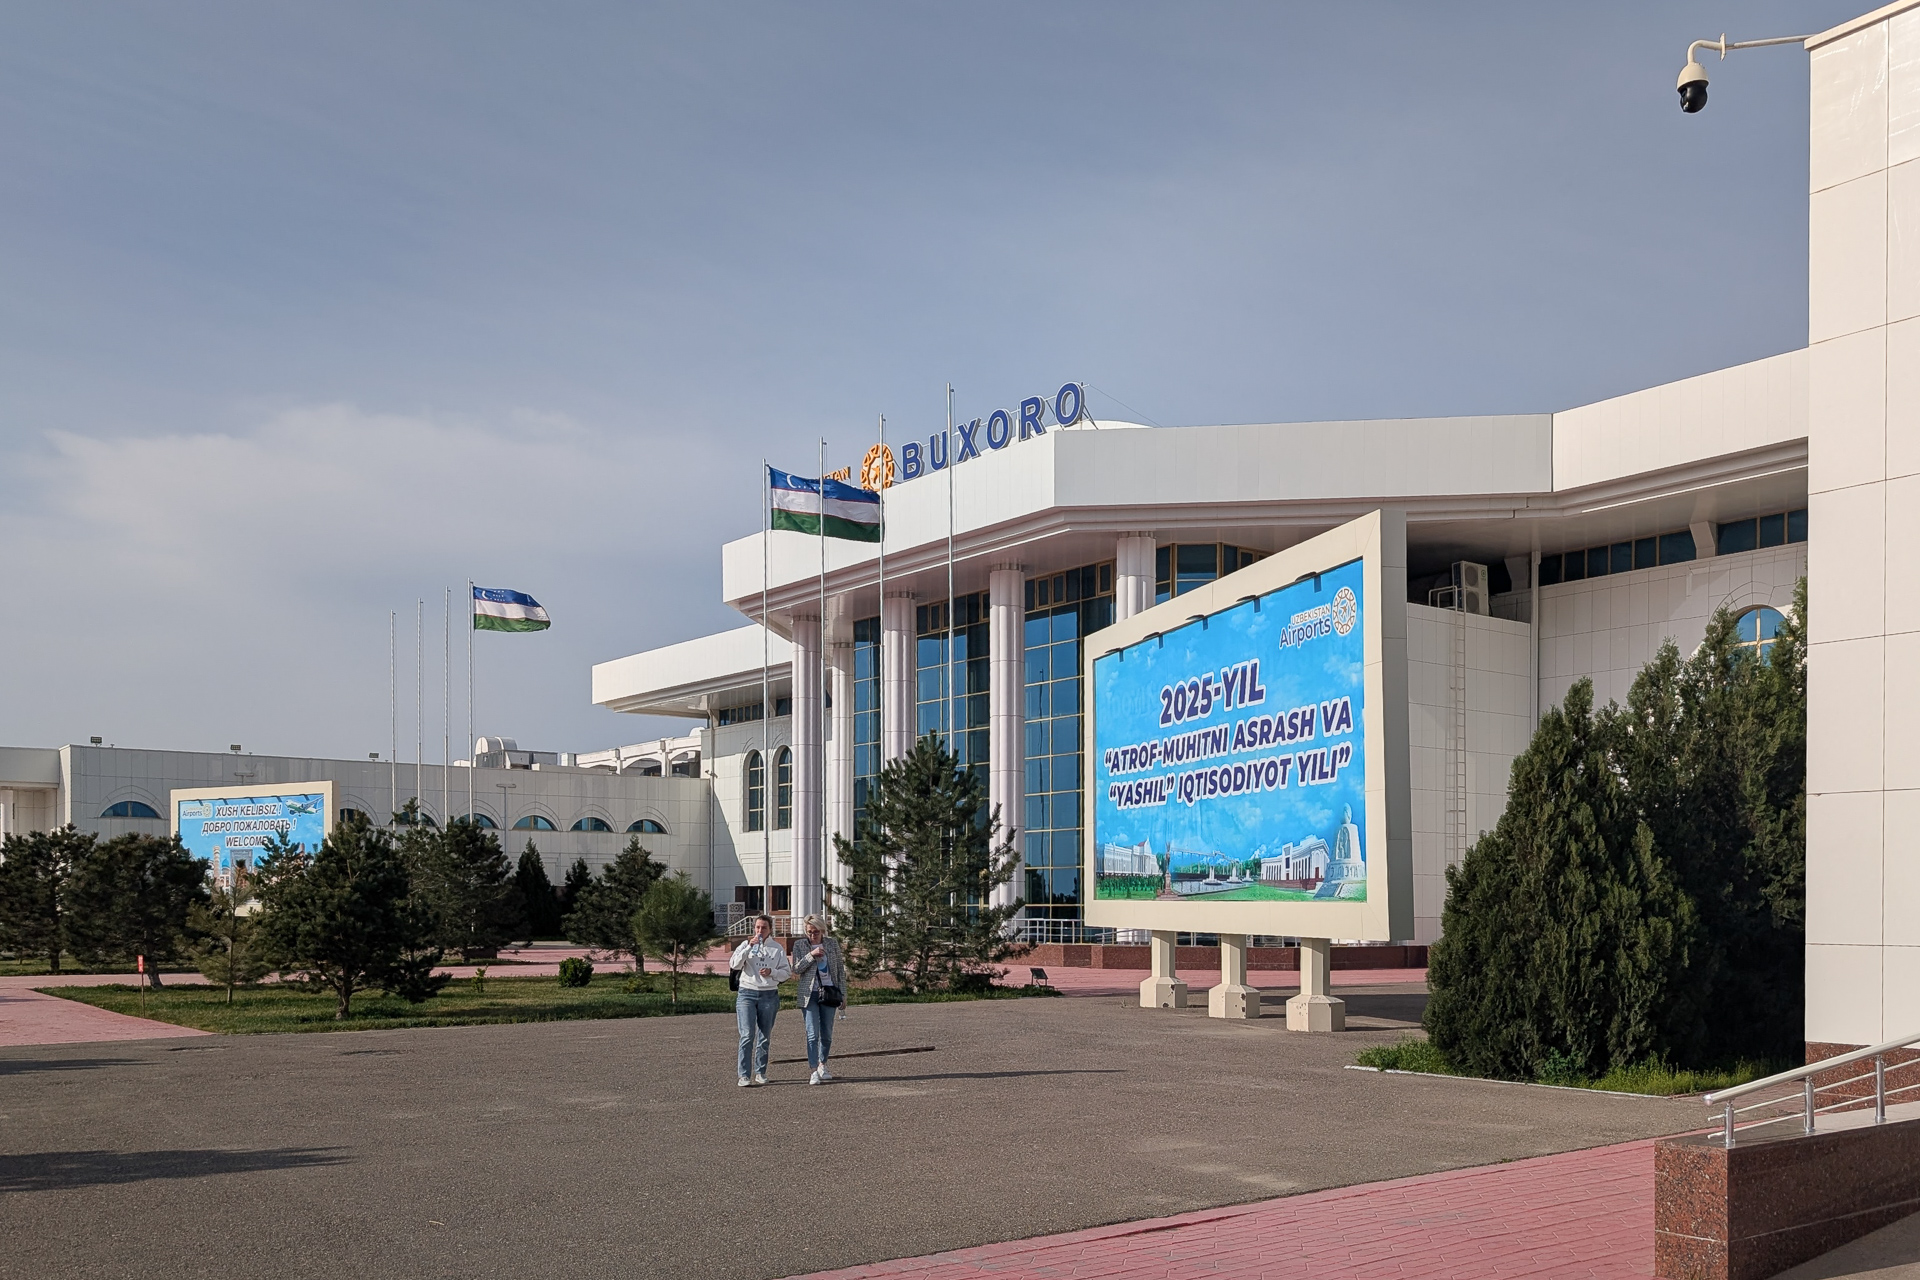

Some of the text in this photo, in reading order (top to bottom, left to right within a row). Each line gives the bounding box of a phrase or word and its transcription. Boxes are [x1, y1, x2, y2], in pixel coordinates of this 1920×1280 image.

[901, 382, 1084, 480] BUXORO
[1279, 618, 1331, 648] Airports
[1291, 604, 1331, 625] UZBEKISTAN
[1160, 662, 1265, 724] 2025-YIL
[1105, 700, 1351, 773] “ATROF-MUHITNI ASRASH VA
[1109, 745, 1351, 807] “YASHIL” IQTISODIYOT YILI”
[202, 821, 231, 835] ДОБРО
[233, 820, 291, 832] ПОЖАЛОВАТЬ
[216, 806, 238, 817] XUSH
[240, 804, 277, 816] KELIBSIZ
